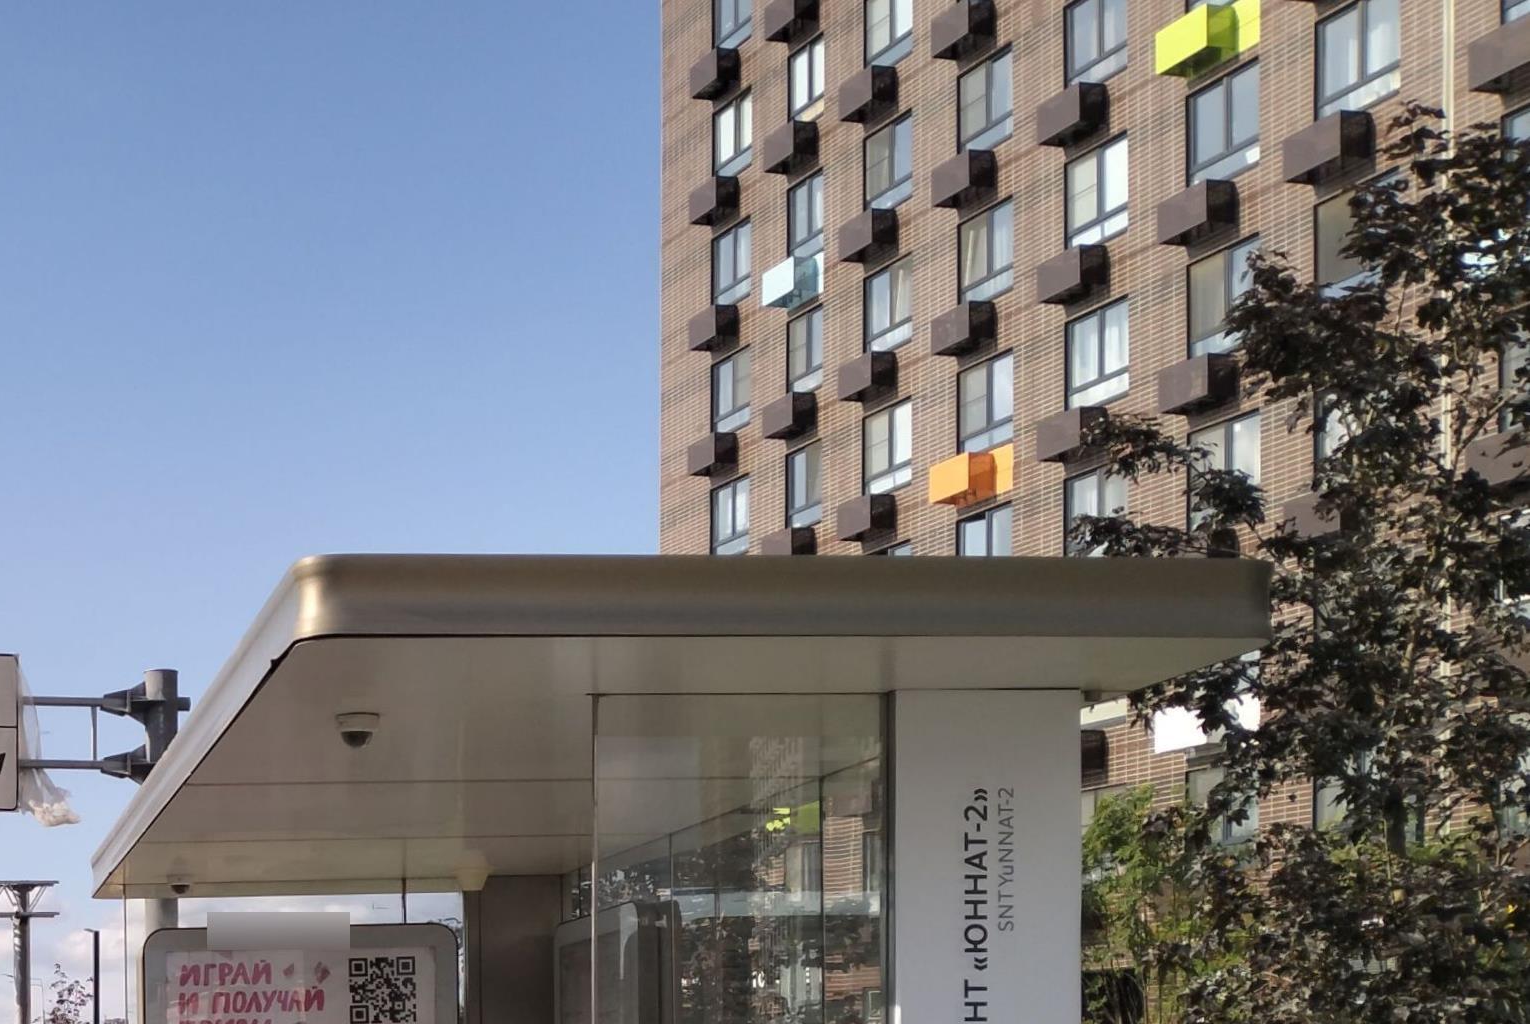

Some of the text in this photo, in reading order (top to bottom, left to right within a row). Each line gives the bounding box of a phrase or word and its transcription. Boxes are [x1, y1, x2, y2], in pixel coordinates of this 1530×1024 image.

[963, 787, 989, 972] «ЮННАТ-2»
[178, 959, 272, 987] ИГРАЙ
[178, 985, 326, 1016] И ПОЛУЧАЙ
